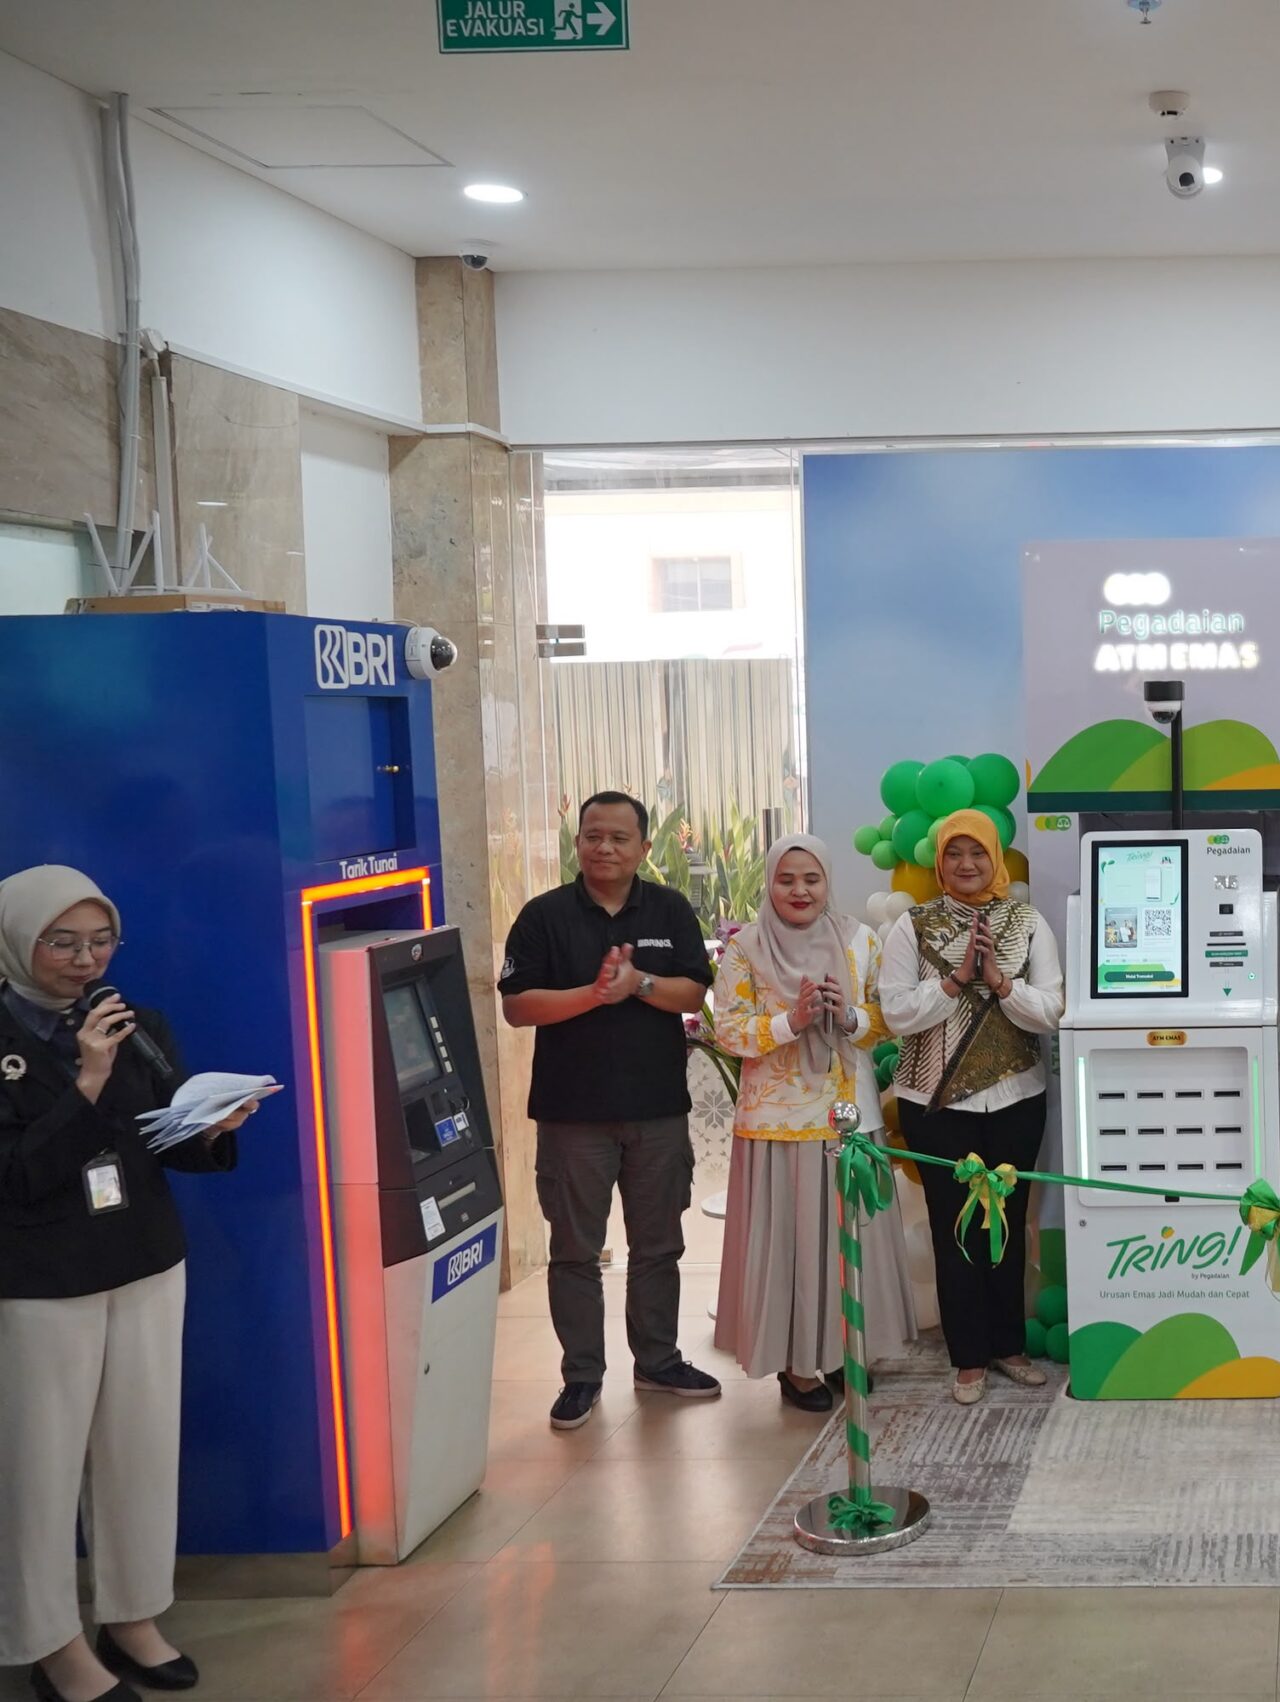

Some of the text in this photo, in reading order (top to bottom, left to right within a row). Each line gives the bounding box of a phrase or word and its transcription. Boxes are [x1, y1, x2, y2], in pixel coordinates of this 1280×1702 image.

[464, 1, 526, 18] JALUR
[446, 18, 544, 37] EVAKUASI
[1099, 609, 1245, 640] Pegadaian
[347, 632, 396, 686] BRI
[1094, 641, 1259, 672] ATM EMAS
[1207, 846, 1250, 856] Pegadaian
[340, 853, 397, 880] Tarik Tunai
[461, 1239, 484, 1275] BRI
[1100, 1290, 1250, 1300] Urusan Emas Jadi Mudah dan Cepat
